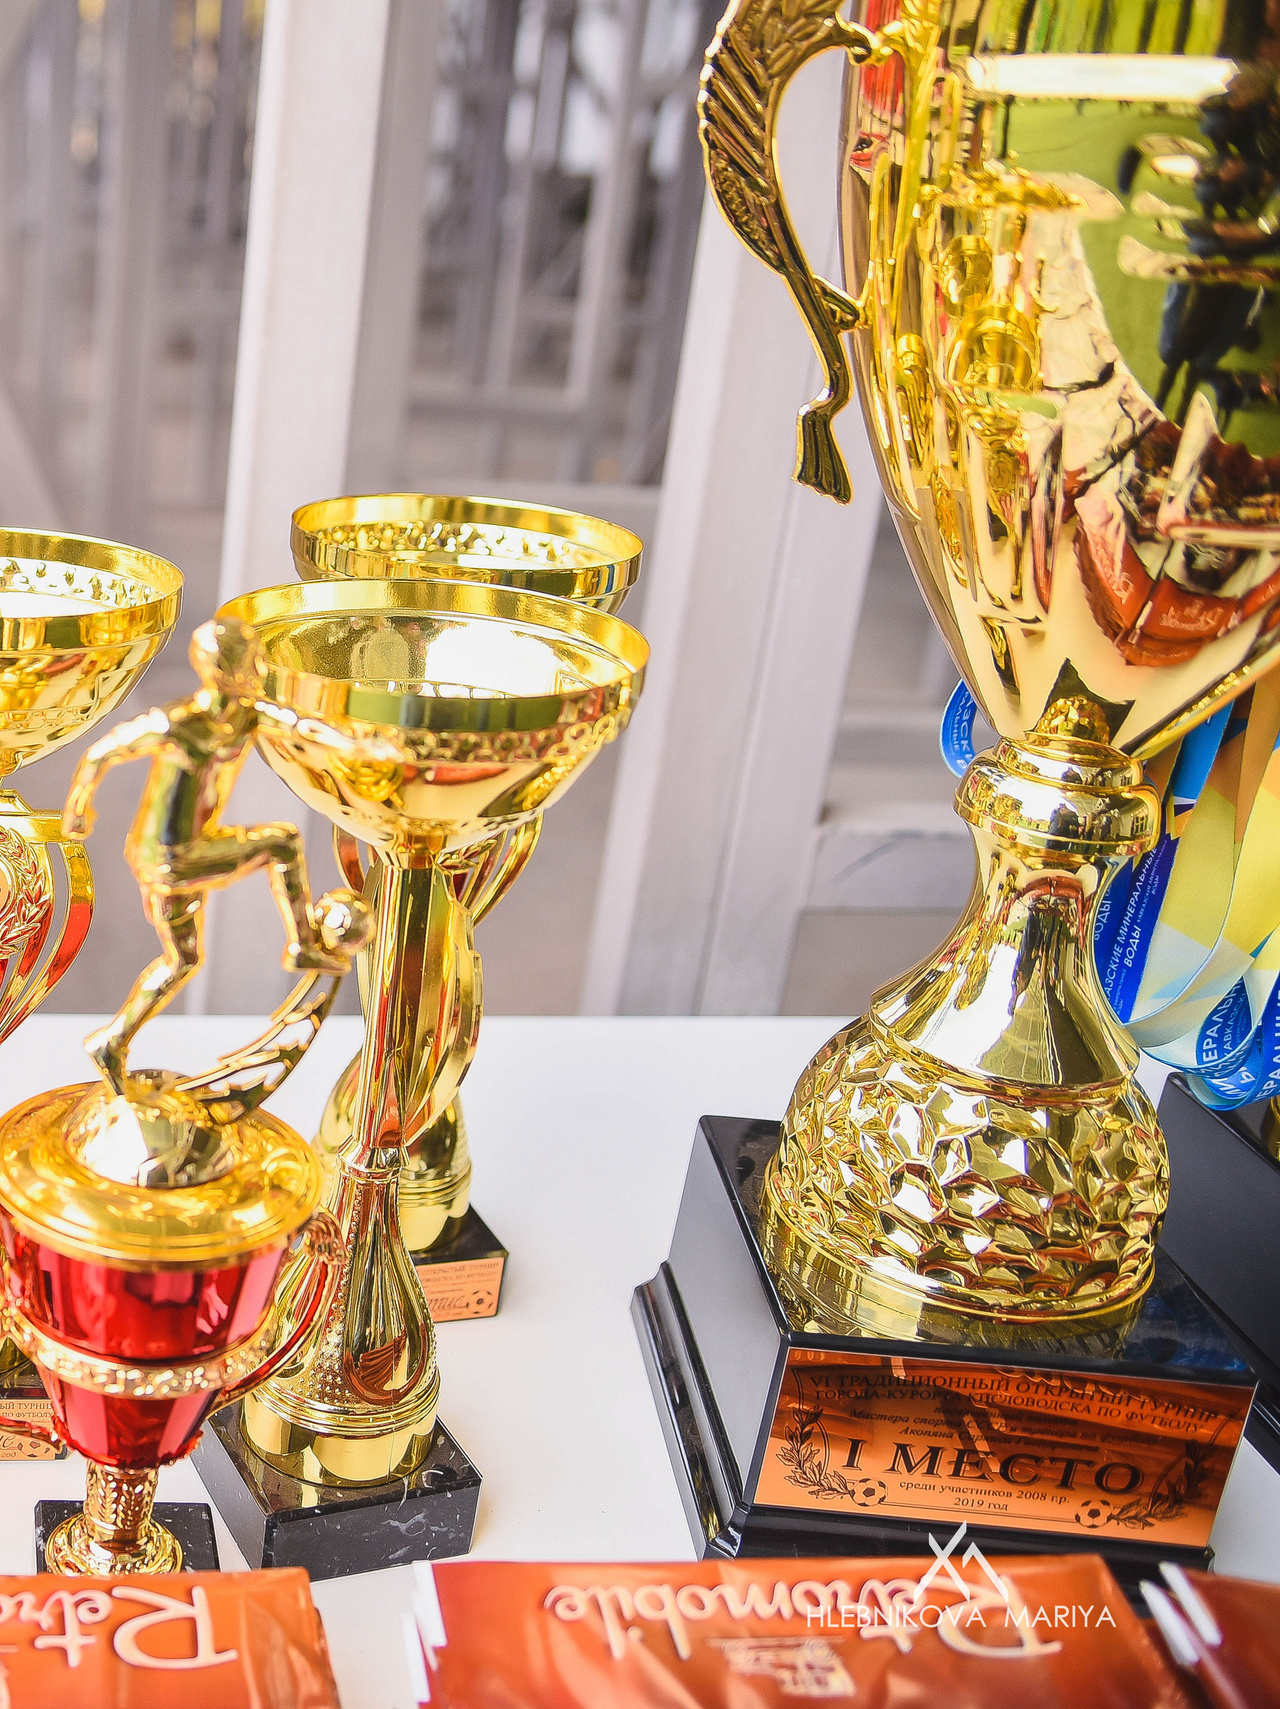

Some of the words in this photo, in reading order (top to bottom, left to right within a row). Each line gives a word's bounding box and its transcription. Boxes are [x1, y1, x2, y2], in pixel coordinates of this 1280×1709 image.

[1124, 925, 1141, 968] ВОДЫ
[1104, 943, 1123, 1000] АЗСКИЕ
[837, 1374, 1011, 1393] ТРАДИЦИОННЫЙ
[1016, 1380, 1136, 1407] ОТКРЫТЫЙ
[815, 1388, 964, 1402] ГОРОДА-КУРОРТА
[969, 1392, 1092, 1415] КИСЛОВОДСКА
[1097, 1406, 1122, 1418] ПО
[1125, 1409, 1205, 1433] ФУТБОЛУ
[849, 1409, 910, 1425] Мастера
[913, 1415, 963, 1430] спорта
[899, 1426, 955, 1440] Акопяна
[1, 1450, 17, 1458] год
[882, 1441, 1146, 1495] МЕСТО
[899, 1479, 936, 1493] среди
[938, 1482, 1013, 1499] участников
[1016, 1489, 1048, 1502] 2008
[953, 1496, 985, 1509] 2019
[987, 1501, 1009, 1512] год
[544, 1573, 1063, 1660] Retromobile
